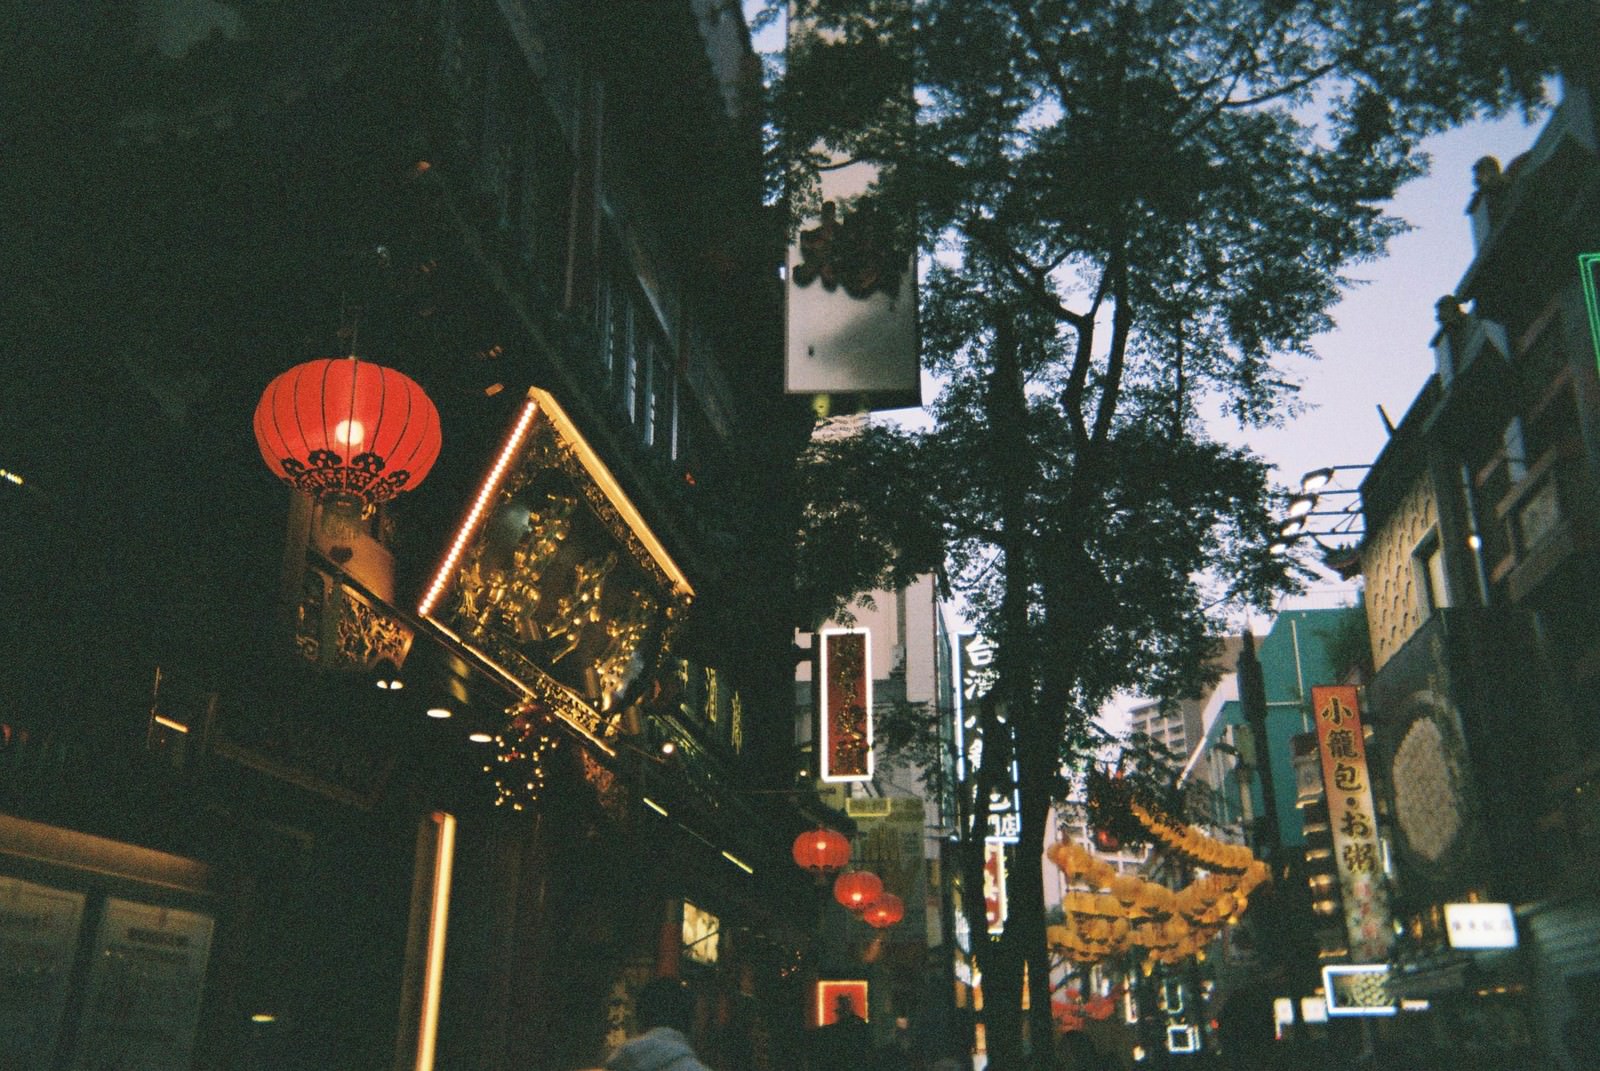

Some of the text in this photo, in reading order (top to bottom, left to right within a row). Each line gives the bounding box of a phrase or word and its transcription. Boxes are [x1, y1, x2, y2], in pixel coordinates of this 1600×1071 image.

[1321, 697, 1378, 873] 小籠包・お粥
